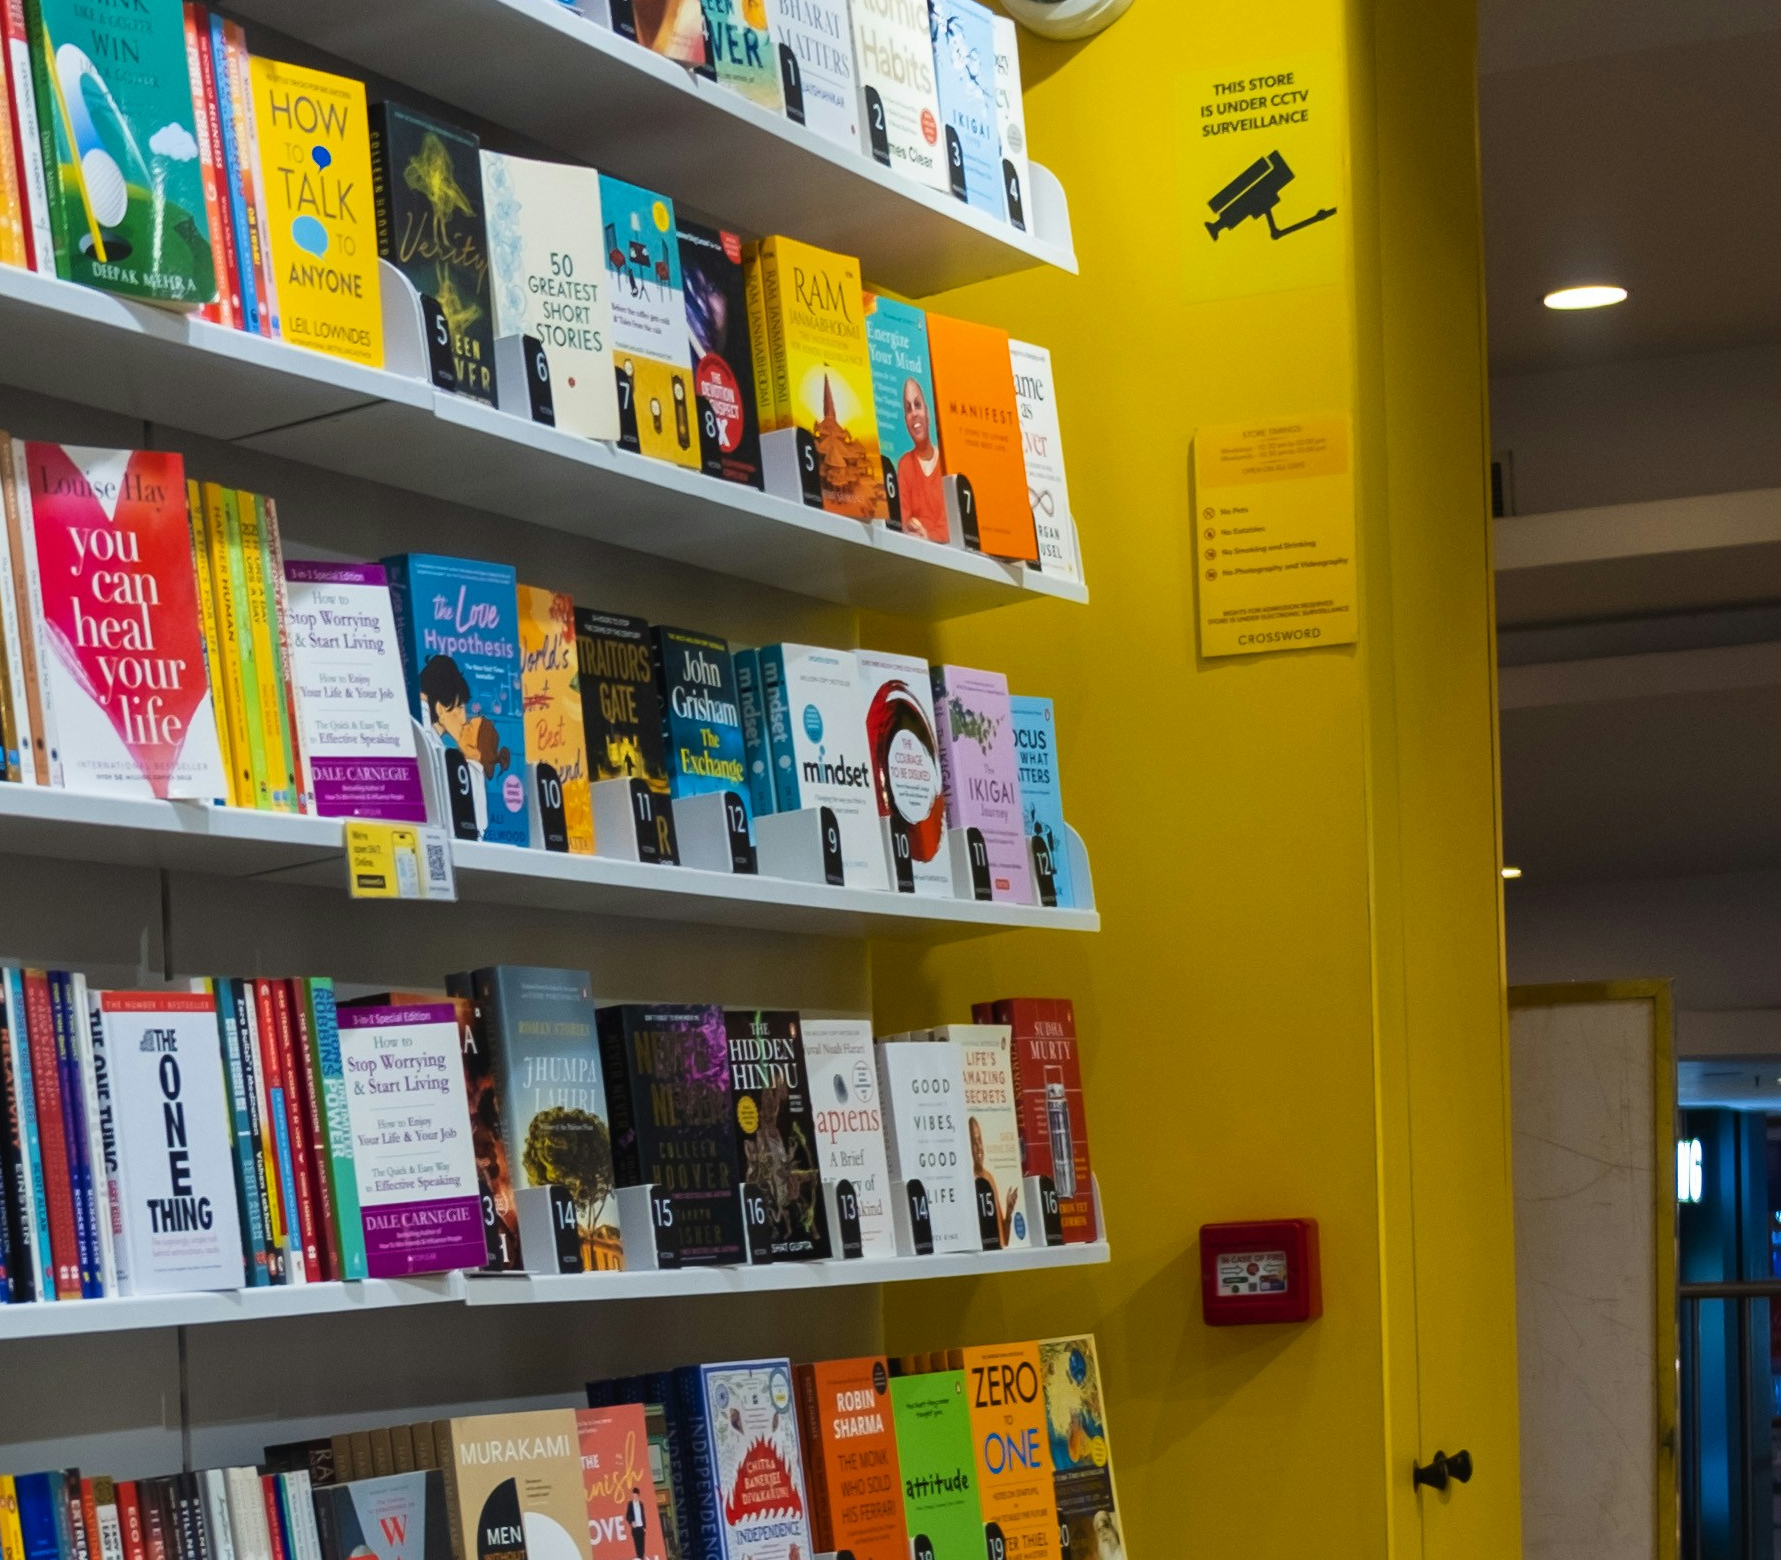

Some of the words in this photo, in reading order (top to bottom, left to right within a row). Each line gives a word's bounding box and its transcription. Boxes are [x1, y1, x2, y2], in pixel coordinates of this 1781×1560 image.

[1214, 80, 1245, 96] THIS
[1249, 72, 1294, 91] STORE
[270, 88, 348, 136] HOW
[1201, 105, 1212, 118] IS
[1216, 97, 1267, 115] UNDER
[1270, 90, 1309, 107] CCTV
[1202, 109, 1308, 137] SURVEILLANCE
[284, 141, 304, 164] TO
[277, 167, 357, 224] TALK
[336, 233, 356, 257] TO
[549, 252, 573, 278] 50
[288, 263, 363, 298] ANYONE
[528, 276, 598, 303] GREATEST
[792, 267, 852, 324] RAM
[542, 301, 590, 324] SHORT
[535, 322, 602, 352] STORIES
[69, 525, 140, 575] you
[91, 570, 160, 606] can
[72, 599, 153, 652] heal
[1238, 628, 1321, 645] CROSSWORD
[423, 628, 515, 661] Hypothesis
[97, 655, 186, 703] your
[120, 695, 183, 745] life
[803, 744, 870, 789] mindset
[729, 803, 747, 834] 12
[730, 1040, 795, 1062] HIDDEN
[912, 1078, 950, 1095] GOOD
[913, 1114, 955, 1132] VIBES,
[919, 1151, 957, 1169] GOOD
[147, 1197, 213, 1234] THING
[748, 1198, 764, 1225] 16
[836, 1389, 876, 1411] ROBIN
[972, 1362, 1038, 1408] ZERO
[834, 1413, 884, 1438] SHARMA
[460, 1435, 570, 1465] MURAKAMI
[985, 1431, 1042, 1475] ONE
